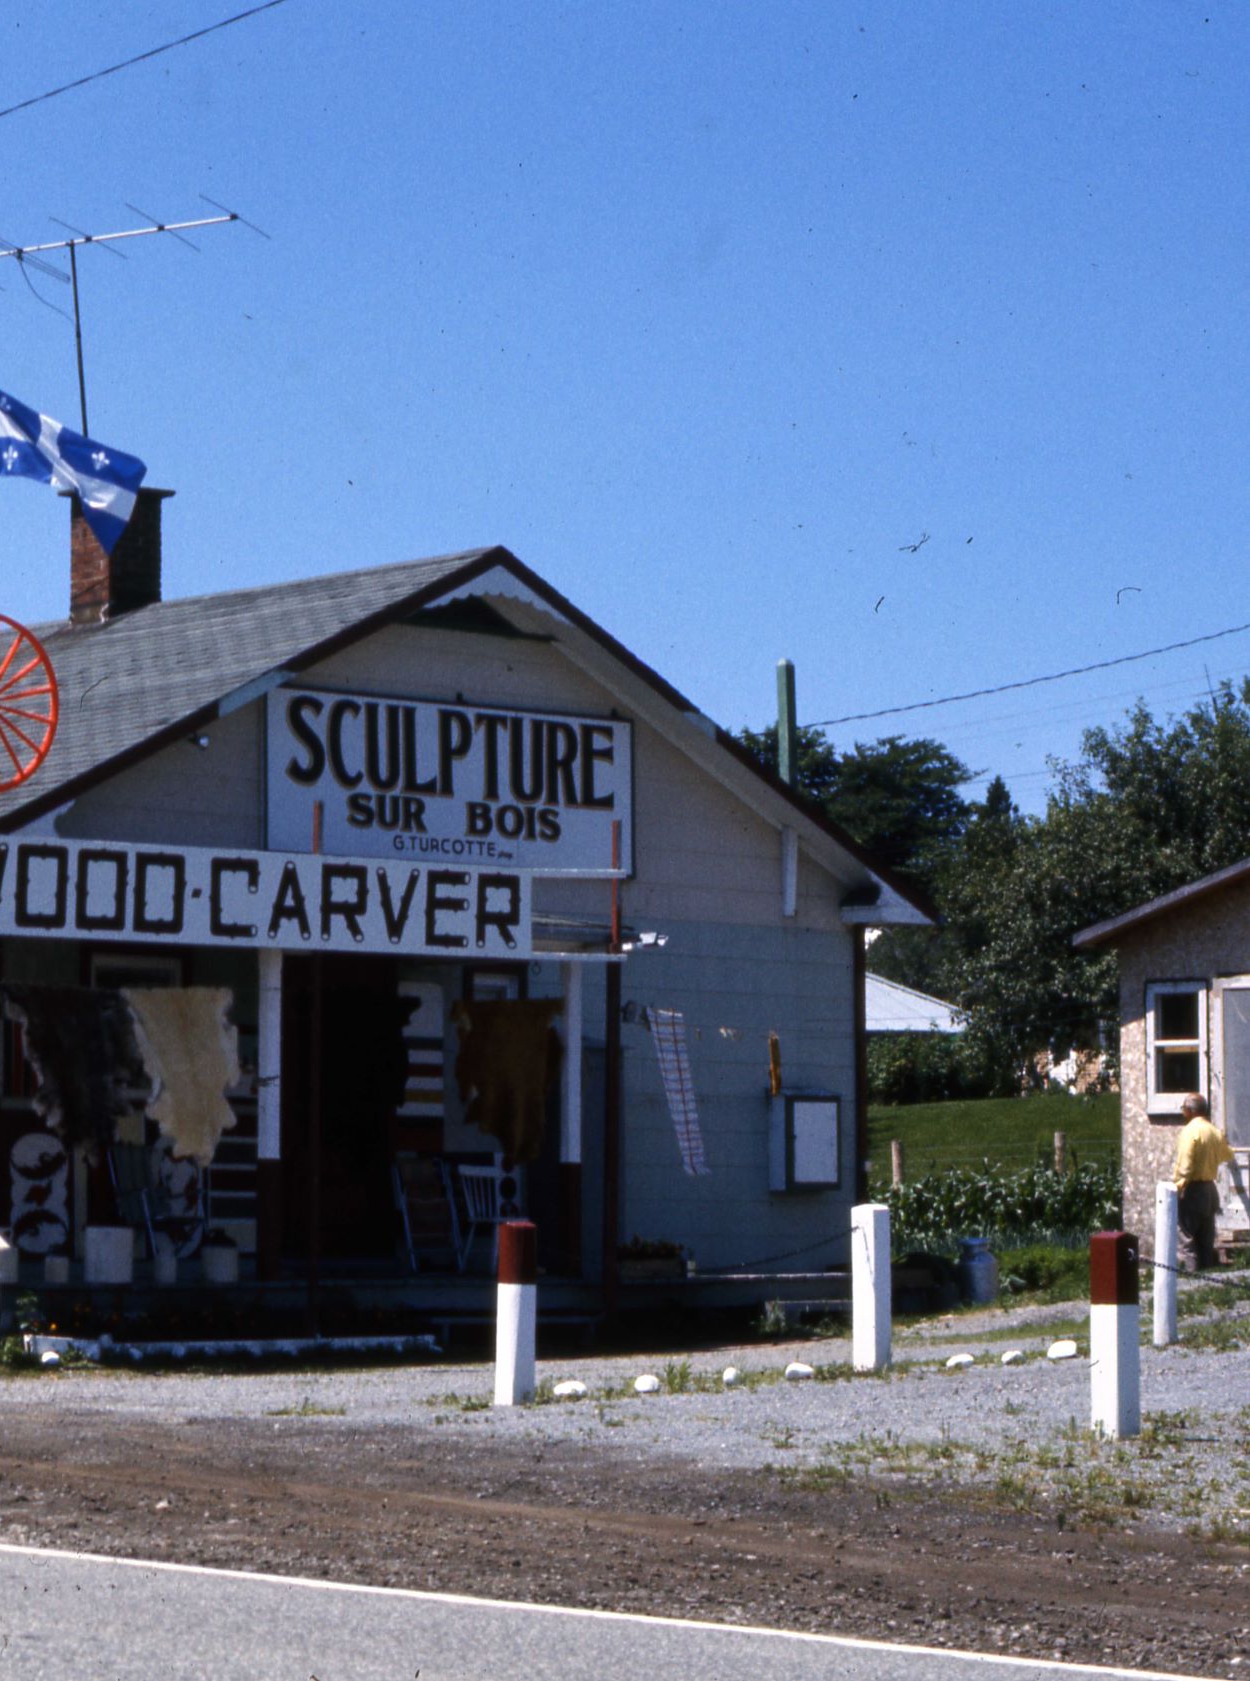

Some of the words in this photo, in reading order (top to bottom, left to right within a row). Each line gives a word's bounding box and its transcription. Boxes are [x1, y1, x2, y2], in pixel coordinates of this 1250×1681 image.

[286, 695, 615, 811] SCULPTURE
[347, 793, 427, 835] SUR
[466, 801, 561, 843] BOIS
